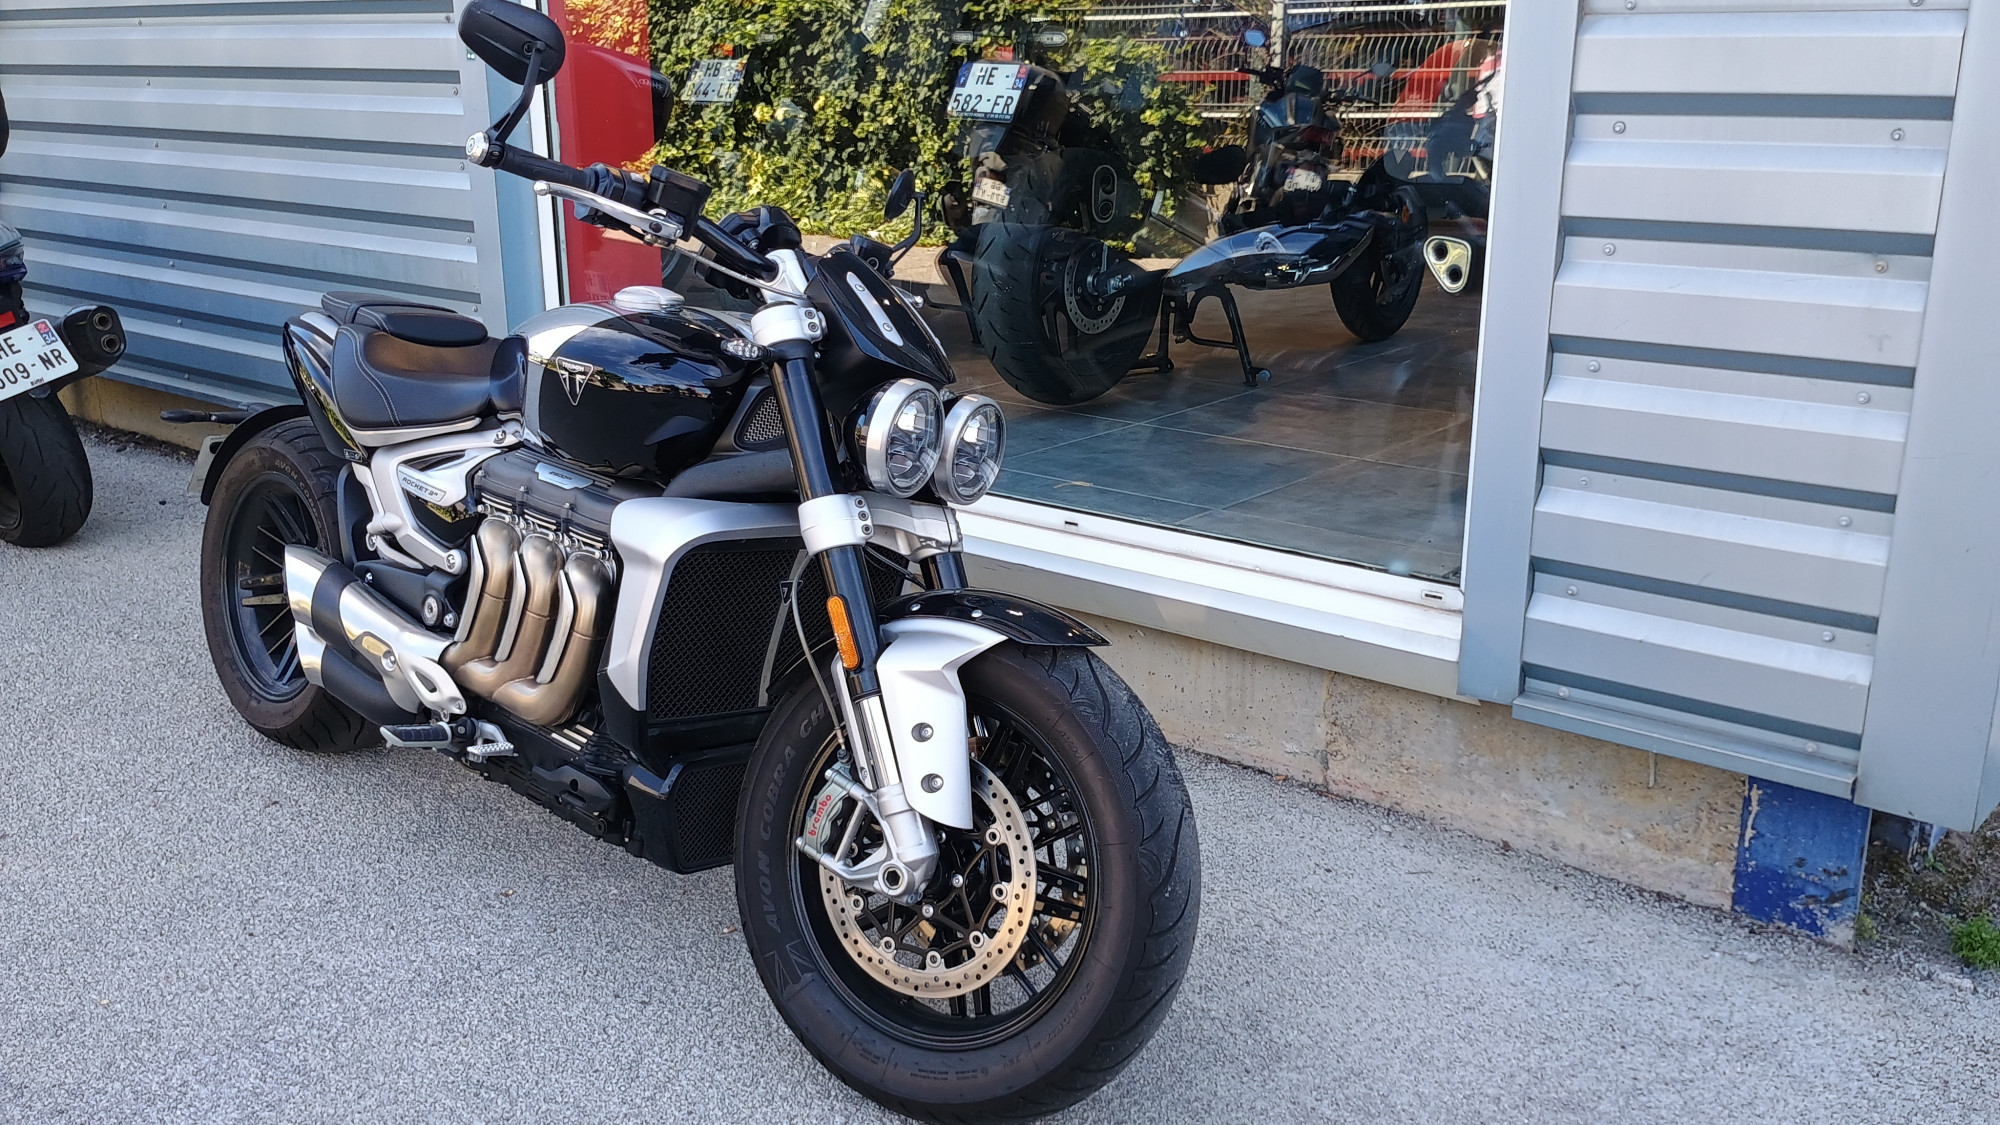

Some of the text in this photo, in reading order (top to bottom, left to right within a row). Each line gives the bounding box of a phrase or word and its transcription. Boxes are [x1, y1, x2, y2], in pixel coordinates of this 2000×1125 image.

[704, 62, 722, 77] HB
[976, 67, 999, 85] HE
[1013, 78, 1024, 88] 34
[952, 93, 1014, 114] 582-FR
[42, 331, 57, 344] 34
[402, 476, 429, 493] ROCKET
[760, 745, 796, 841] COBRA
[808, 794, 832, 836] brembo
[758, 851, 781, 934] AVON
